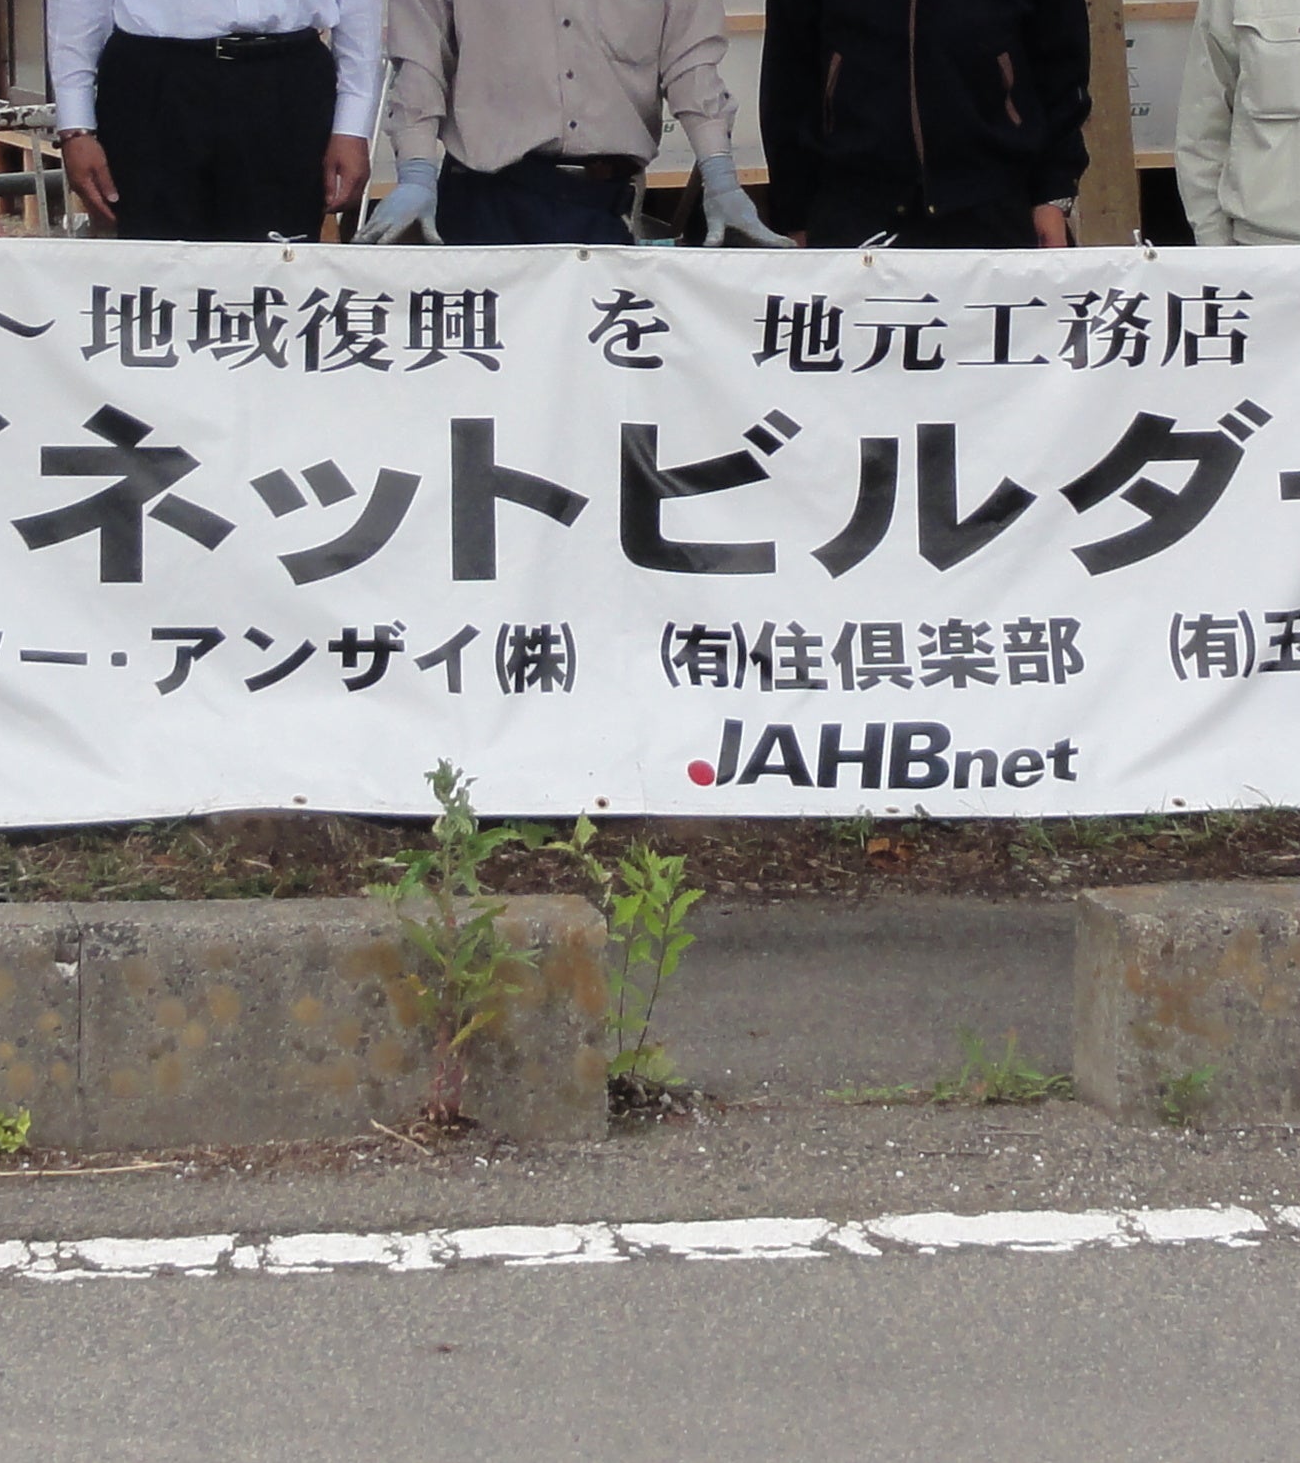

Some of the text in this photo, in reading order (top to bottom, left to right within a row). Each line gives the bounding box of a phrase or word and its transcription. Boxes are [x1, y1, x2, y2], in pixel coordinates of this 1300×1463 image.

[587, 287, 671, 371] を
[751, 284, 1255, 374] 地元工務店
[686, 718, 1080, 791] JAHBnet
